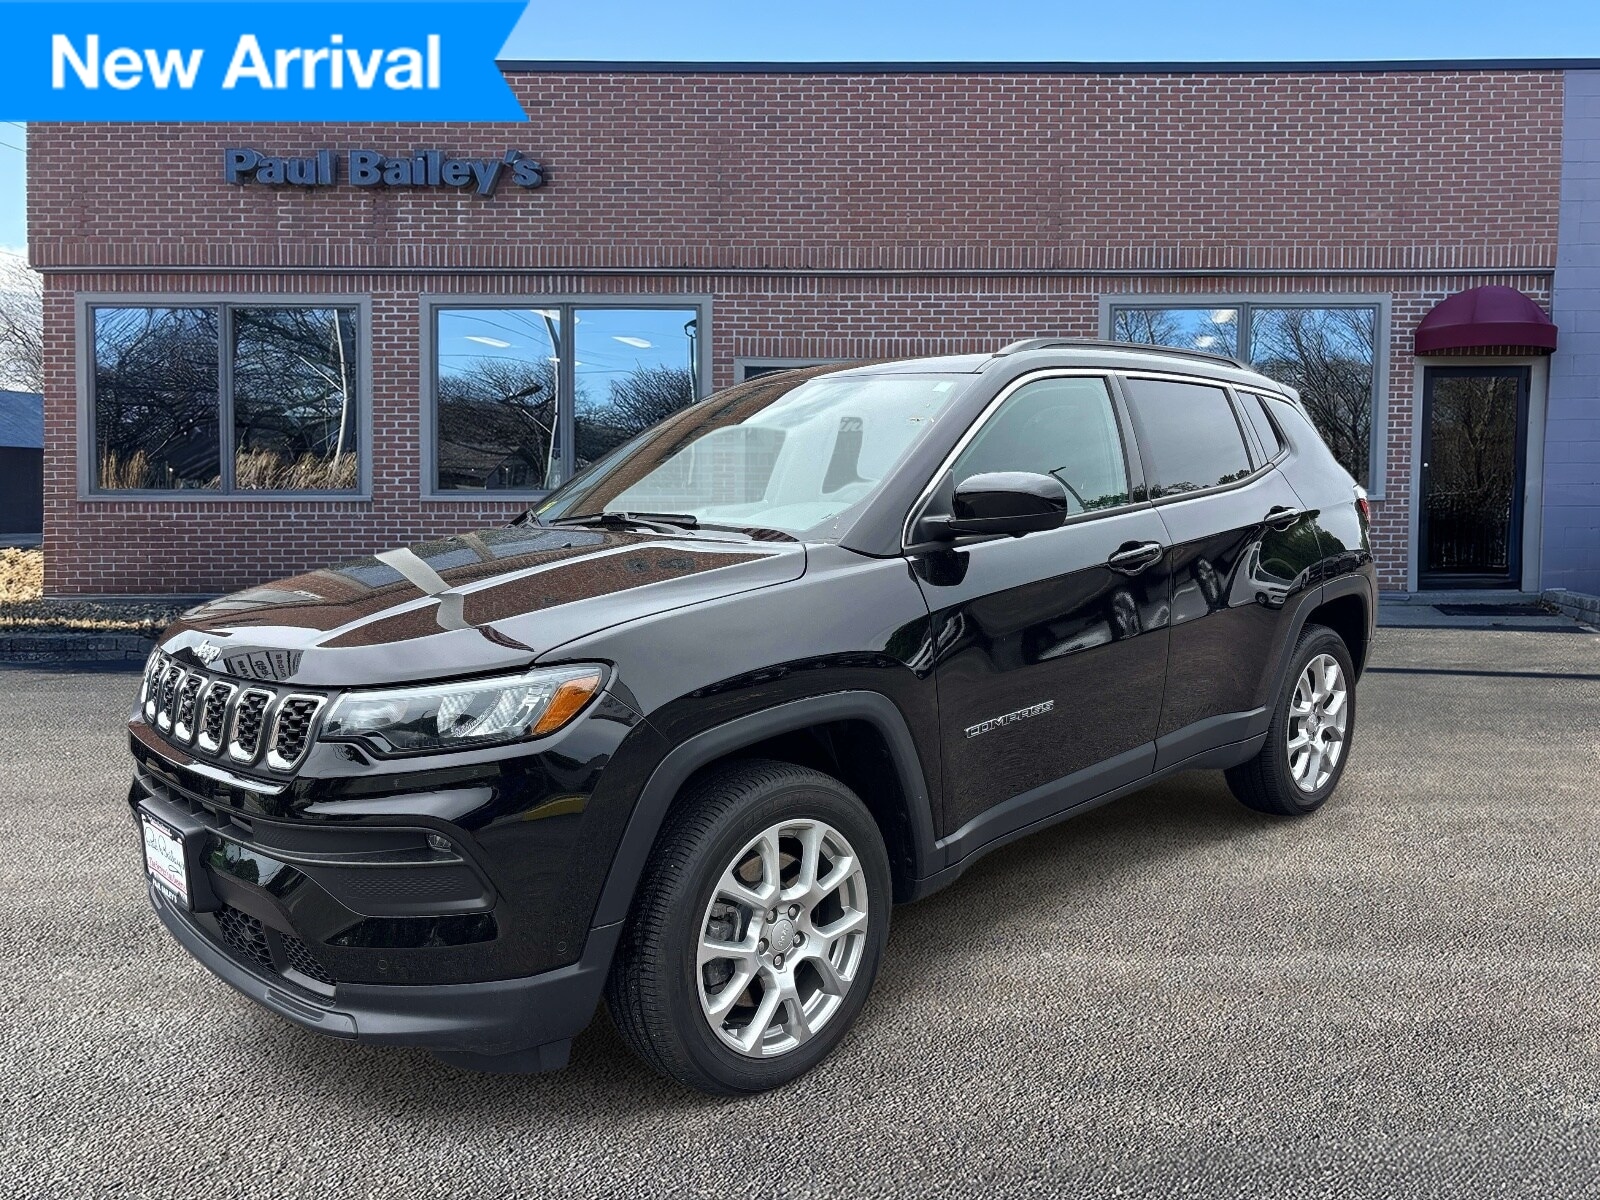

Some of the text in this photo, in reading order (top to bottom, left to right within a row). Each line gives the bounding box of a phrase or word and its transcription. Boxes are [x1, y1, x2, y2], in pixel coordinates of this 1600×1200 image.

[224, 148, 545, 197] Paul Bailey's
[964, 700, 1055, 738] COMPASS
